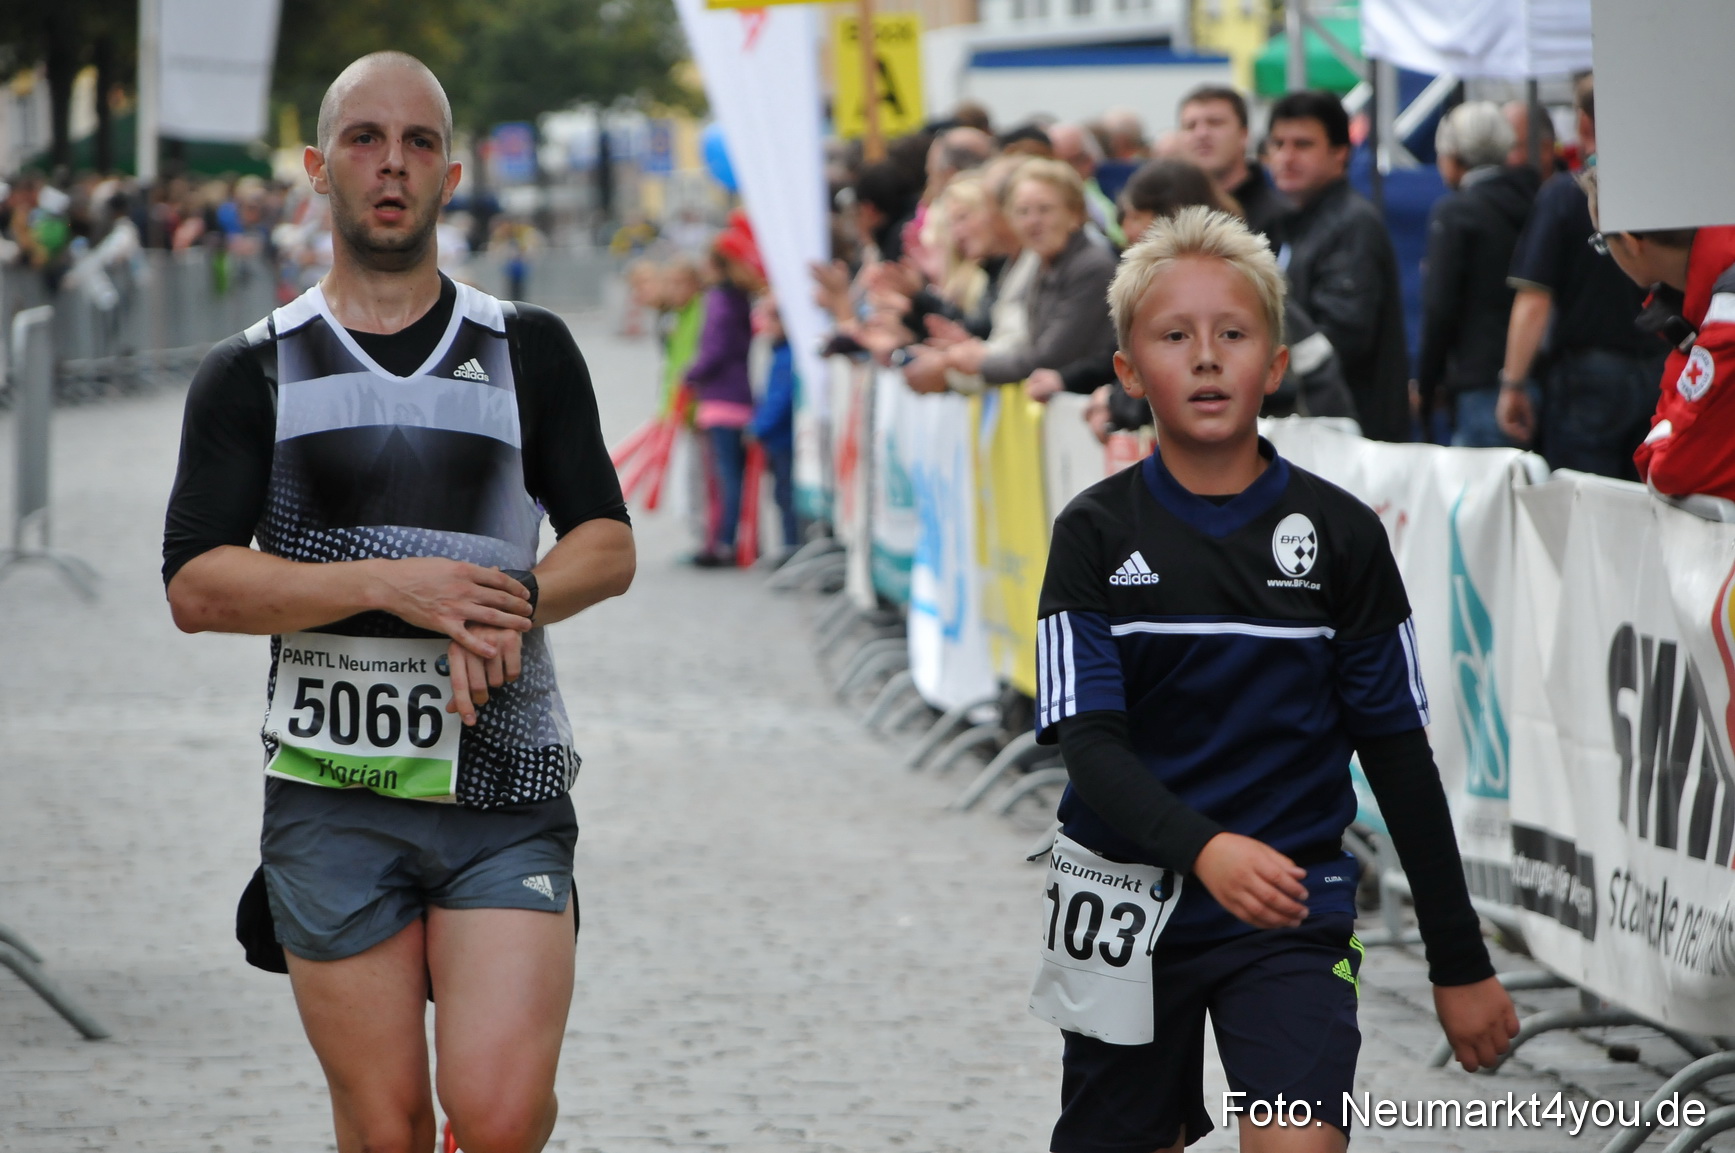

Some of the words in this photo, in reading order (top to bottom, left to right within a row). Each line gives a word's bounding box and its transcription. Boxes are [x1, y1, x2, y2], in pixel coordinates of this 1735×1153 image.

[453, 369, 490, 382] adidas
[1280, 534, 1307, 544] BFV
[1108, 572, 1160, 586] adidas
[282, 648, 336, 669] PARTL
[338, 653, 428, 674] Neumarkt
[288, 676, 444, 749] 5066
[1050, 852, 1143, 894] Neumarkt
[522, 879, 555, 902] adidas
[1043, 881, 1147, 968] 103
